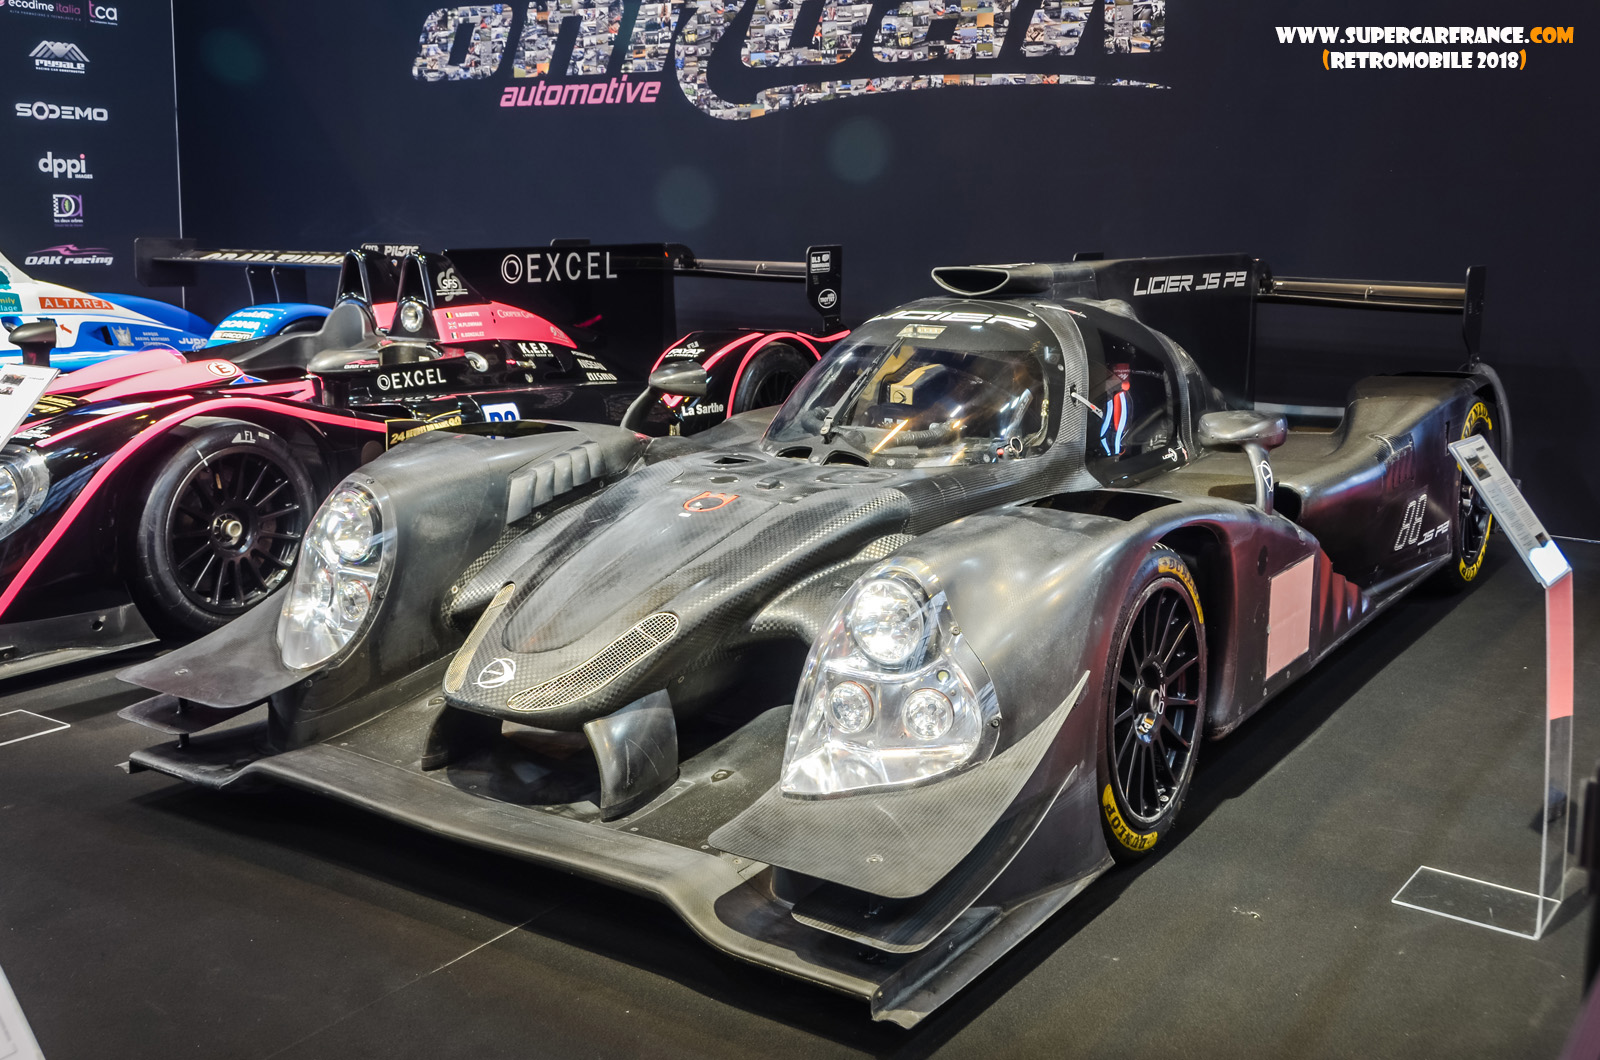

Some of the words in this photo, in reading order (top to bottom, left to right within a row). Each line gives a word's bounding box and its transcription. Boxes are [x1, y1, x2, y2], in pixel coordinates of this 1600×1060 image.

[56, 3, 81, 15] italia
[89, 0, 118, 21] tca
[500, 74, 661, 107] automotive
[15, 101, 108, 121] SODEMO
[38, 151, 86, 179] dppi
[25, 255, 62, 265] OAK
[65, 255, 114, 266] racing
[442, 279, 458, 289] SFS
[1133, 275, 1194, 296] LIGIER
[1195, 272, 1221, 290] JS
[1223, 271, 1247, 288] P2
[45, 298, 110, 309] ALTAREA
[391, 368, 447, 389] EXCEL
[681, 405, 695, 417] La
